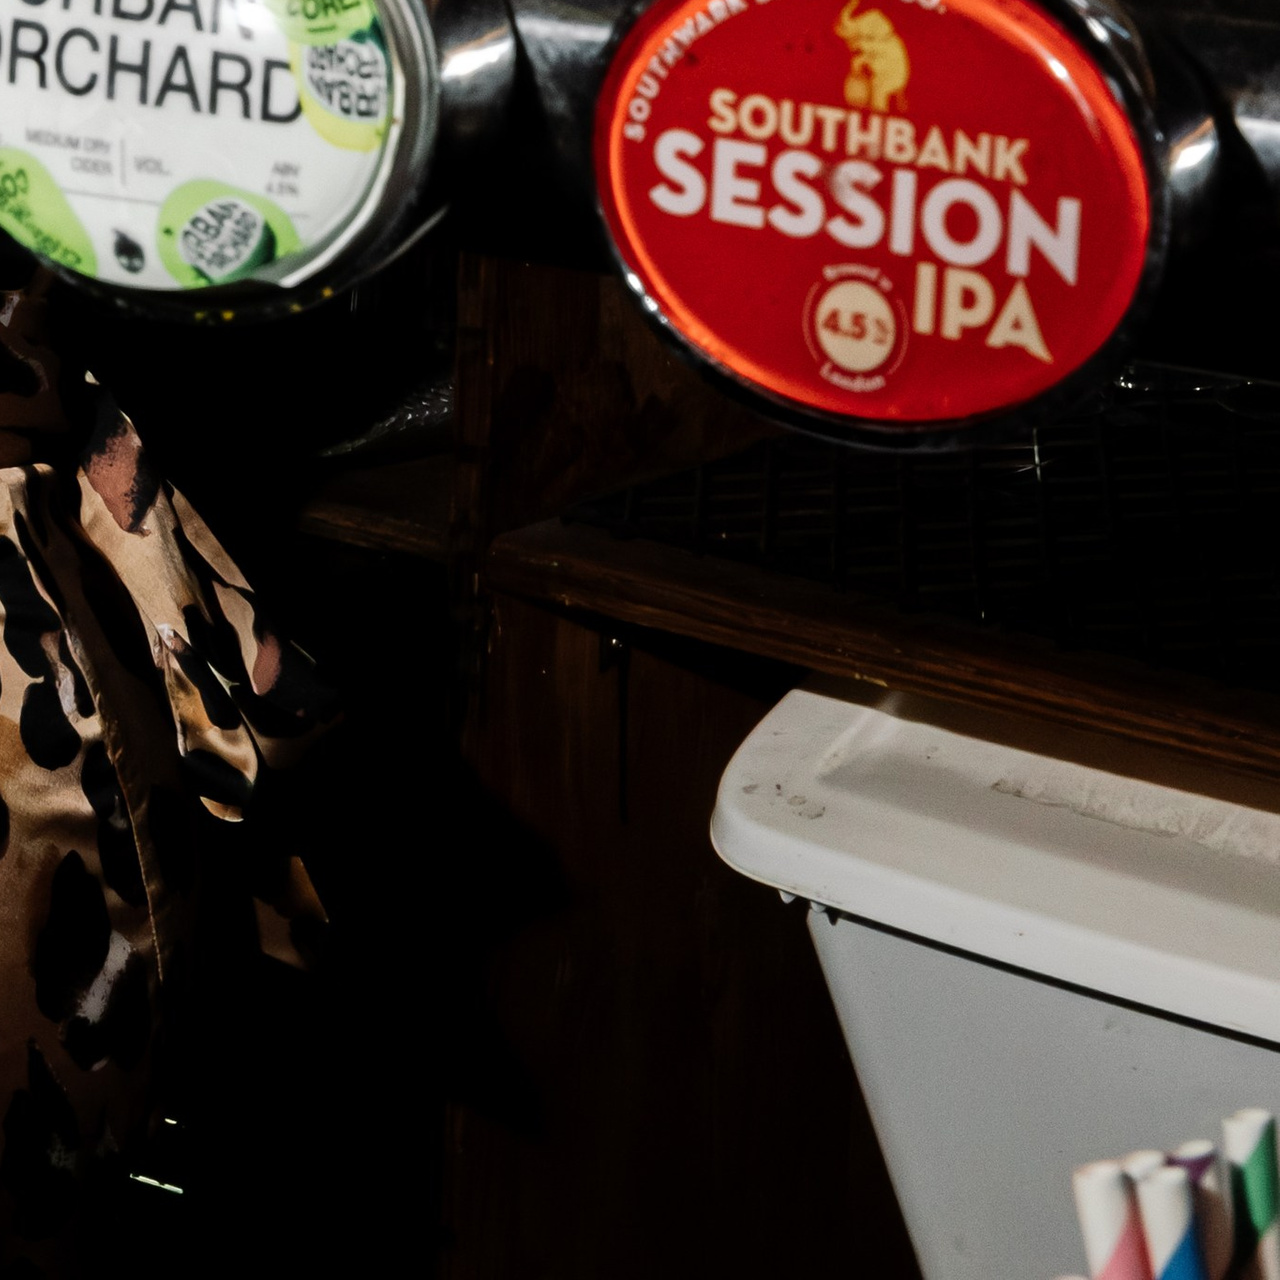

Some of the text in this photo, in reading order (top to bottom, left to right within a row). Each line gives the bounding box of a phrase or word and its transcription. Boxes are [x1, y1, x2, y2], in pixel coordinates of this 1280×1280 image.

[707, 87, 1030, 186] SOUTHBANK
[649, 128, 1081, 287] SESSION
[913, 261, 1055, 364] IPA
